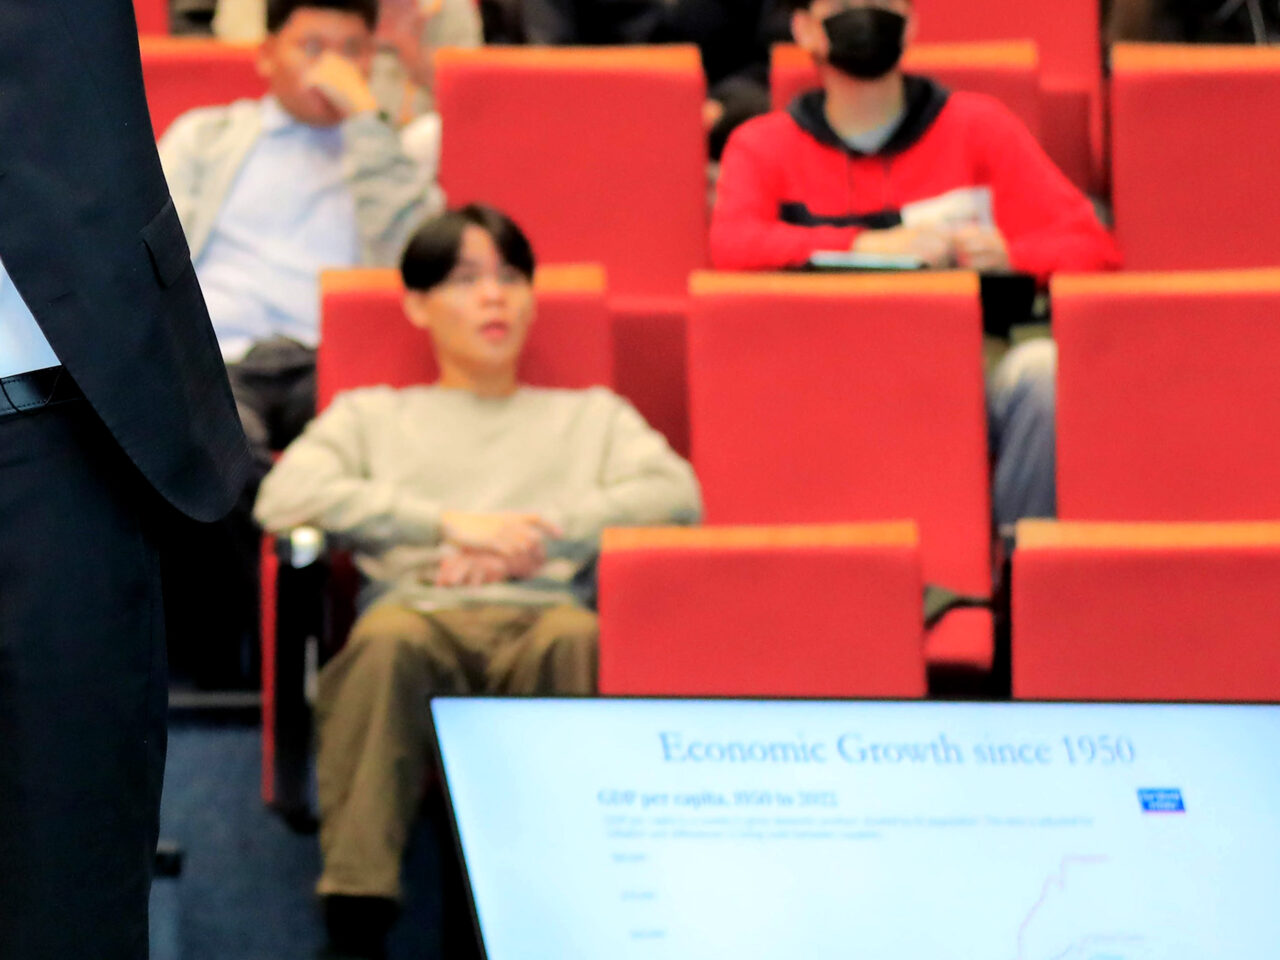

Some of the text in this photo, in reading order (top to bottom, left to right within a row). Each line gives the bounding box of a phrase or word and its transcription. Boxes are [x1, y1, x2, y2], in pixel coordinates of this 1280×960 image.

[658, 731, 1137, 768] Economic Growth since 1950
[642, 793, 669, 811] per
